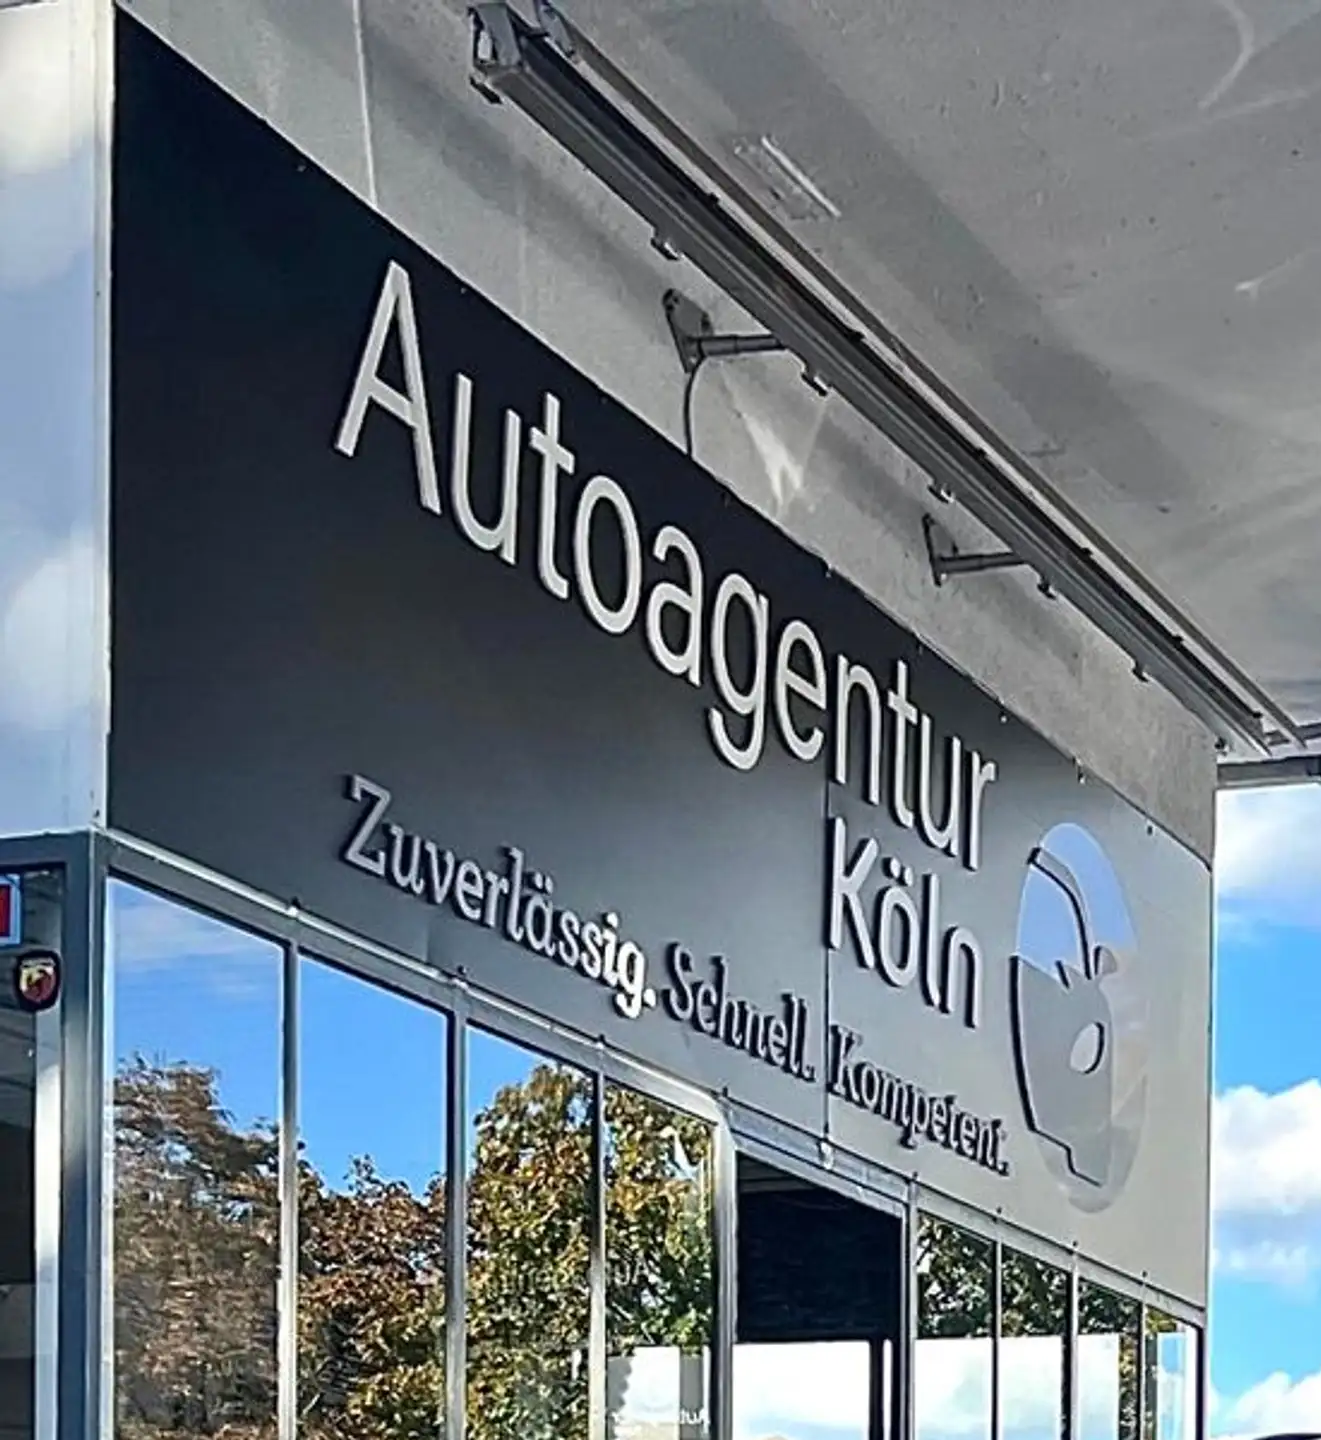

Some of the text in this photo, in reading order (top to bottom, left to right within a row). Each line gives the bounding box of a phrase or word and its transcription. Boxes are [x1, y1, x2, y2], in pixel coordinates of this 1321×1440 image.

[334, 260, 996, 870] Autoagentur
[345, 774, 1009, 1176] Zuverlässig. Schnell. Kompetent.
[829, 816, 982, 1028] Köln
